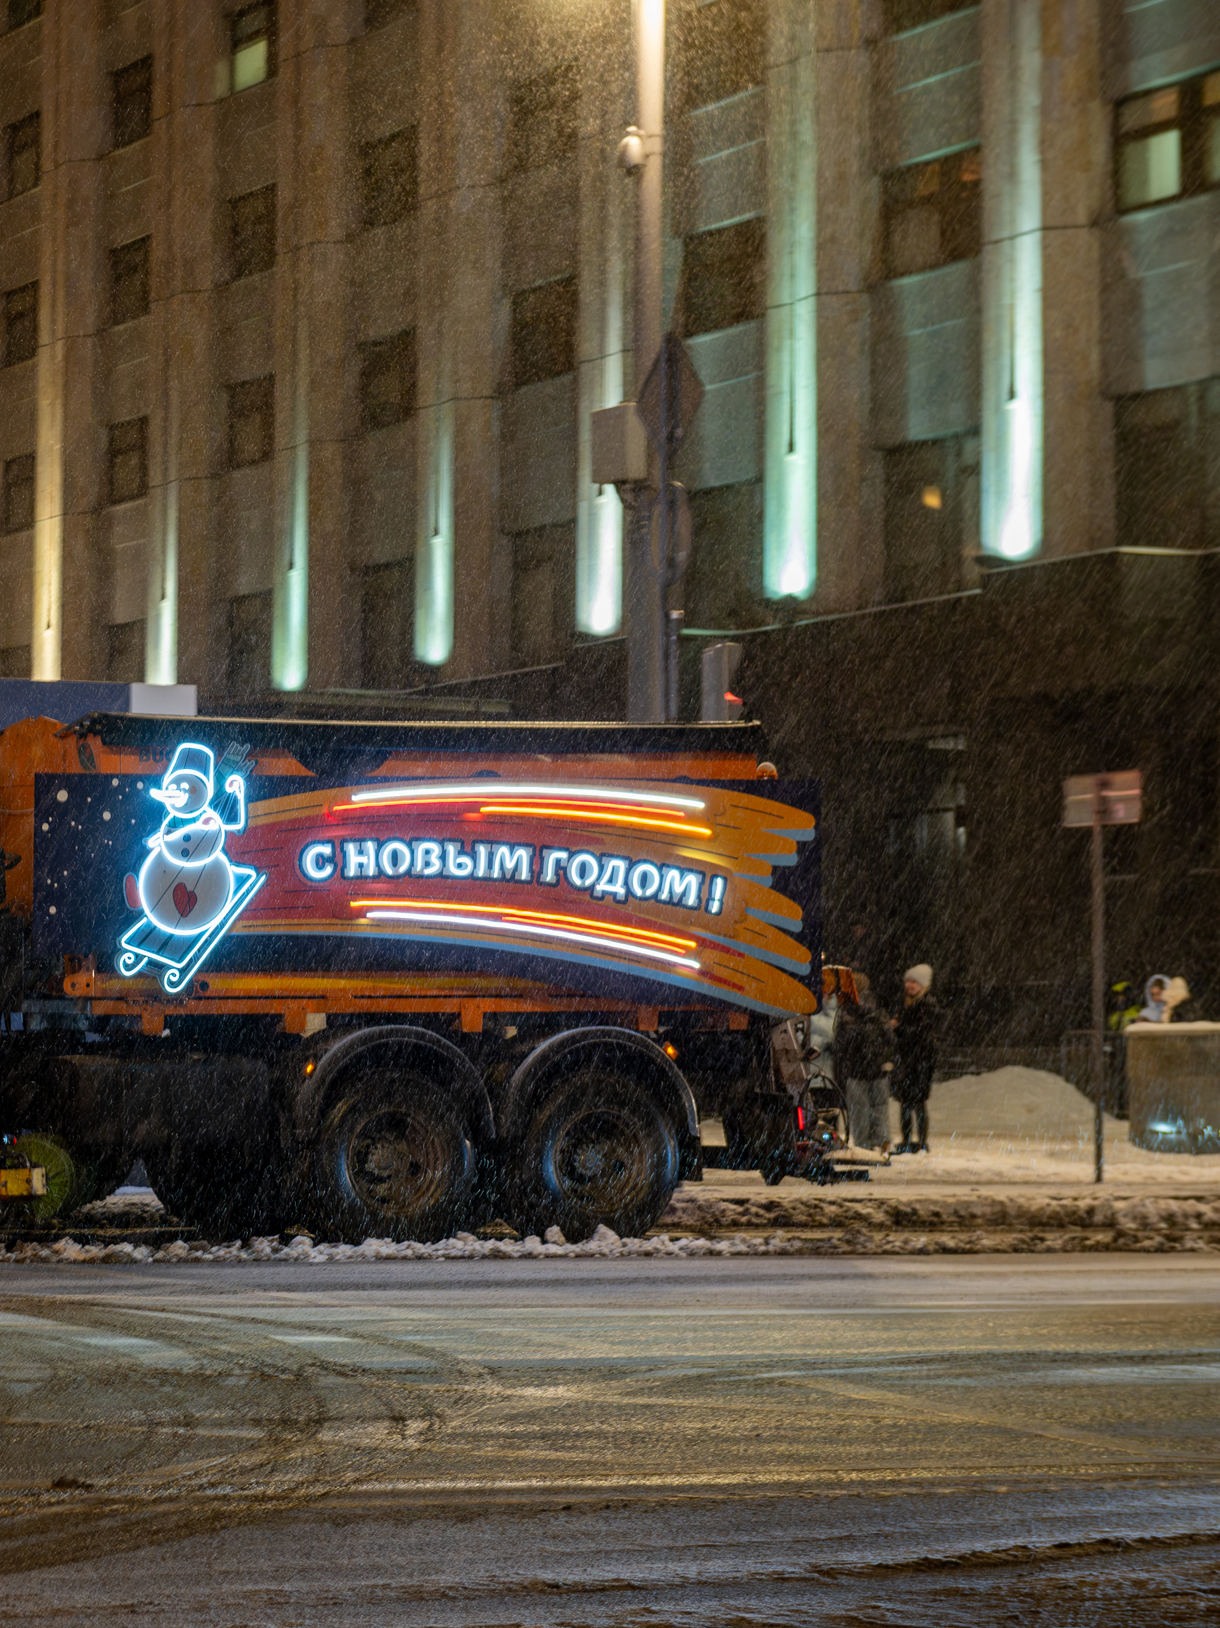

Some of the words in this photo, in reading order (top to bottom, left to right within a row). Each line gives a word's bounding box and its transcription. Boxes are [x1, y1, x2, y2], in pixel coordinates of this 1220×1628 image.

[302, 842, 336, 880] С
[344, 839, 532, 883] НОВЫМ
[541, 846, 727, 916] ГОДОМ!
